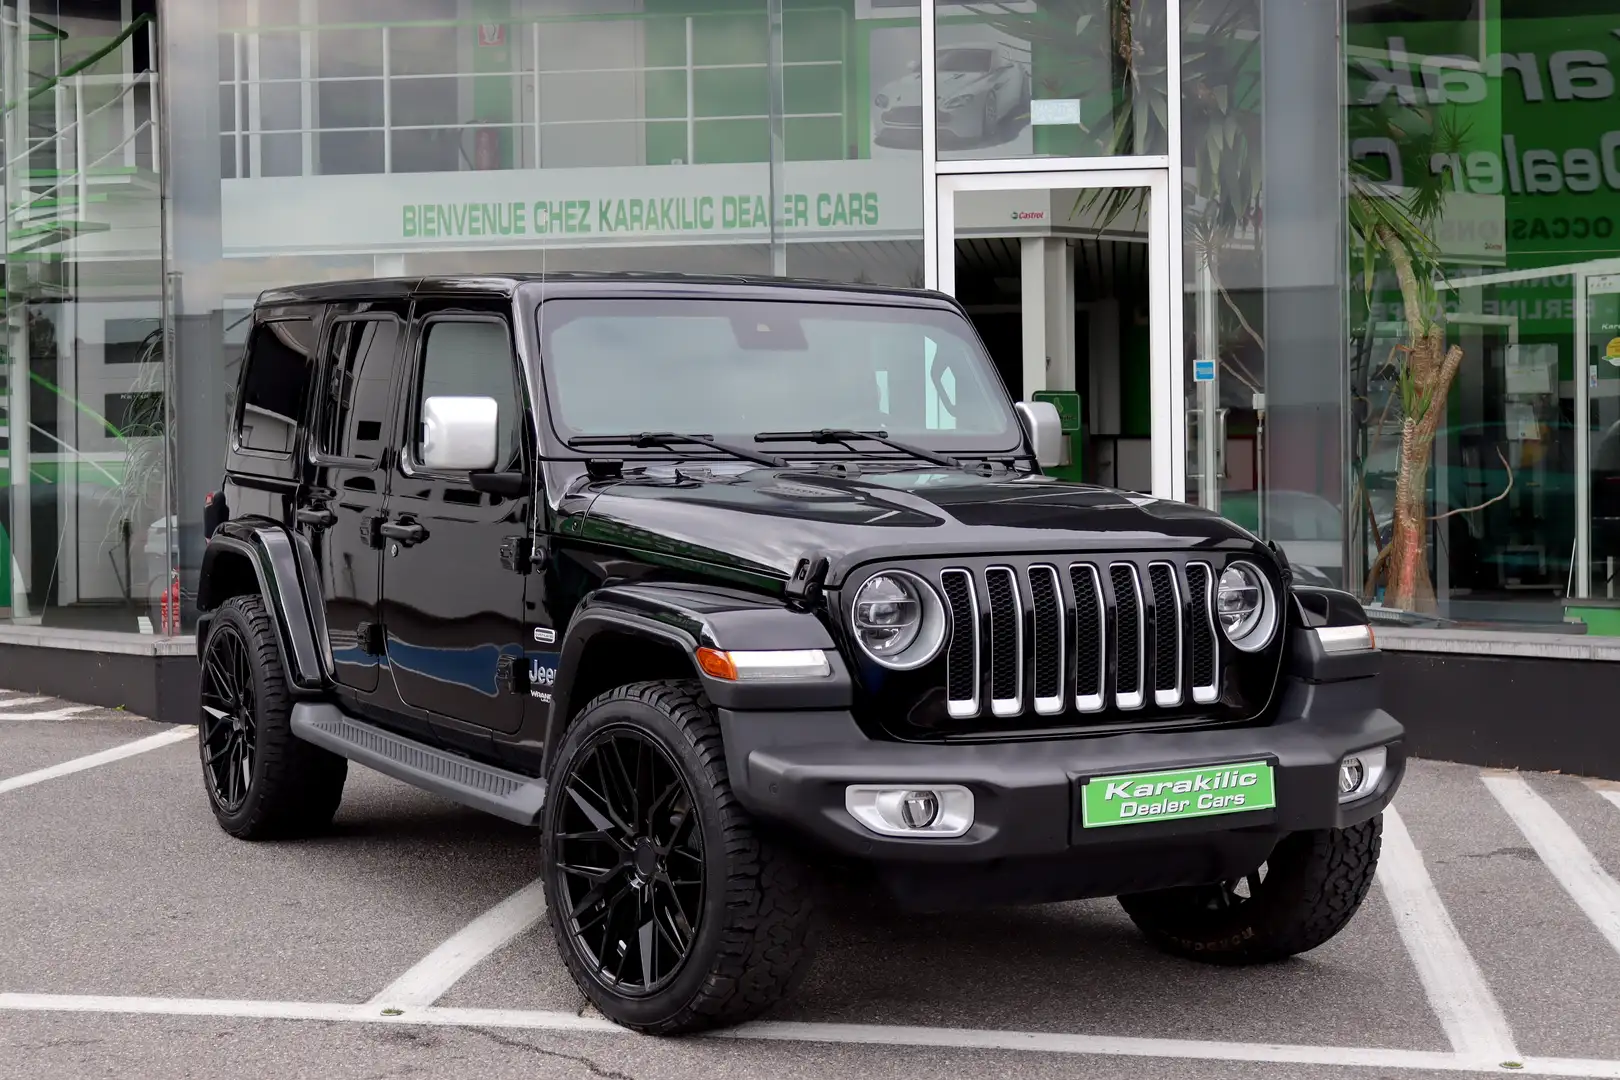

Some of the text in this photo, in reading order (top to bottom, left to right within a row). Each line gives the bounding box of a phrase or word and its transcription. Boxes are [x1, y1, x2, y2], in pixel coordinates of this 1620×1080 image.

[402, 202, 526, 238] BIENVENUE
[533, 200, 591, 234] CHEZ
[599, 196, 714, 232] KARAKILIC
[816, 192, 879, 226] CARS
[1019, 211, 1044, 220] Castrol
[1105, 770, 1257, 800] Karakilic
[1120, 793, 1245, 818] Dealer Cars
